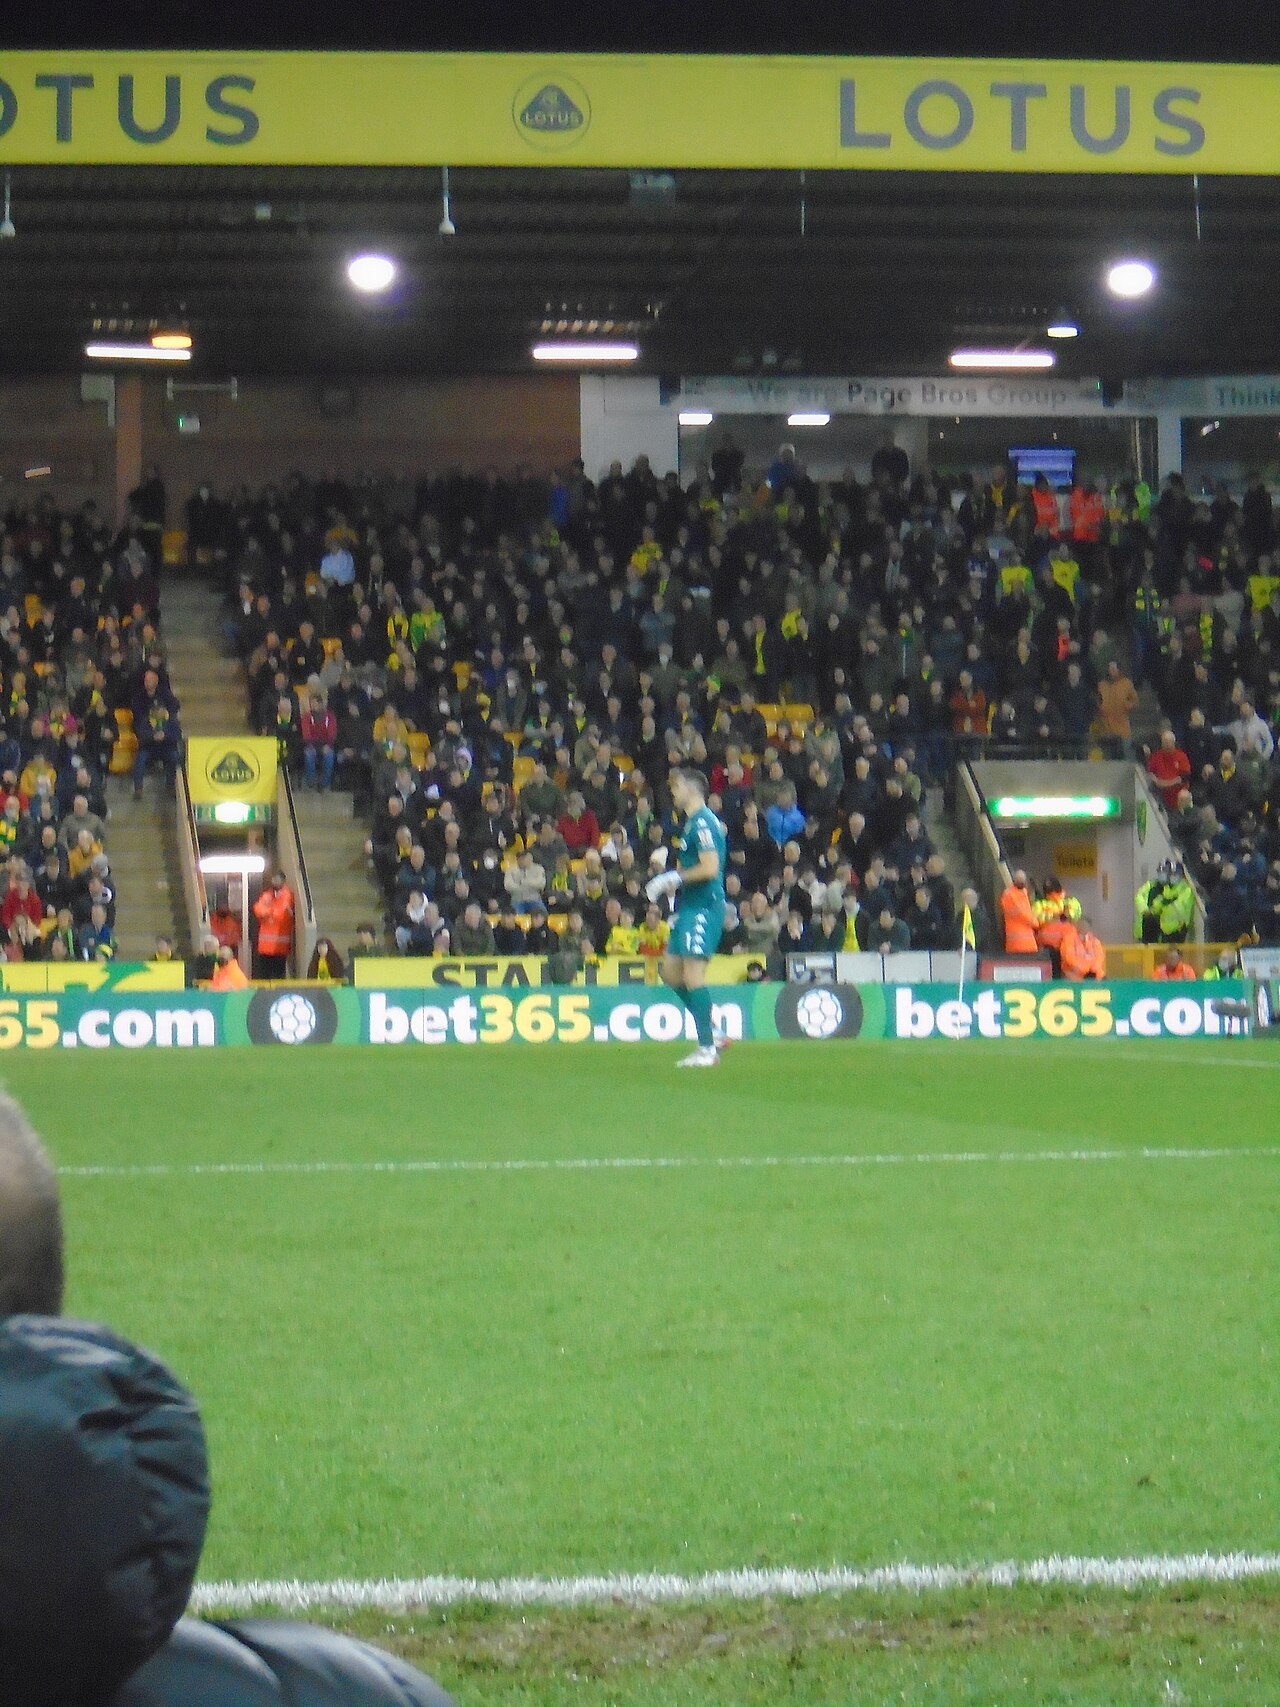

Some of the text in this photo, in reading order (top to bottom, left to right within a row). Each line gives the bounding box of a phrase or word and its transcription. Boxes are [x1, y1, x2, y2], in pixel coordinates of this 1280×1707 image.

[0, 73, 260, 146] TUS
[525, 110, 581, 128] LOTUS
[839, 78, 1206, 157] LOTUS
[846, 381, 912, 409] Page
[920, 381, 978, 404] Bros
[987, 382, 1068, 410] Group
[213, 769, 254, 781] LOTUS
